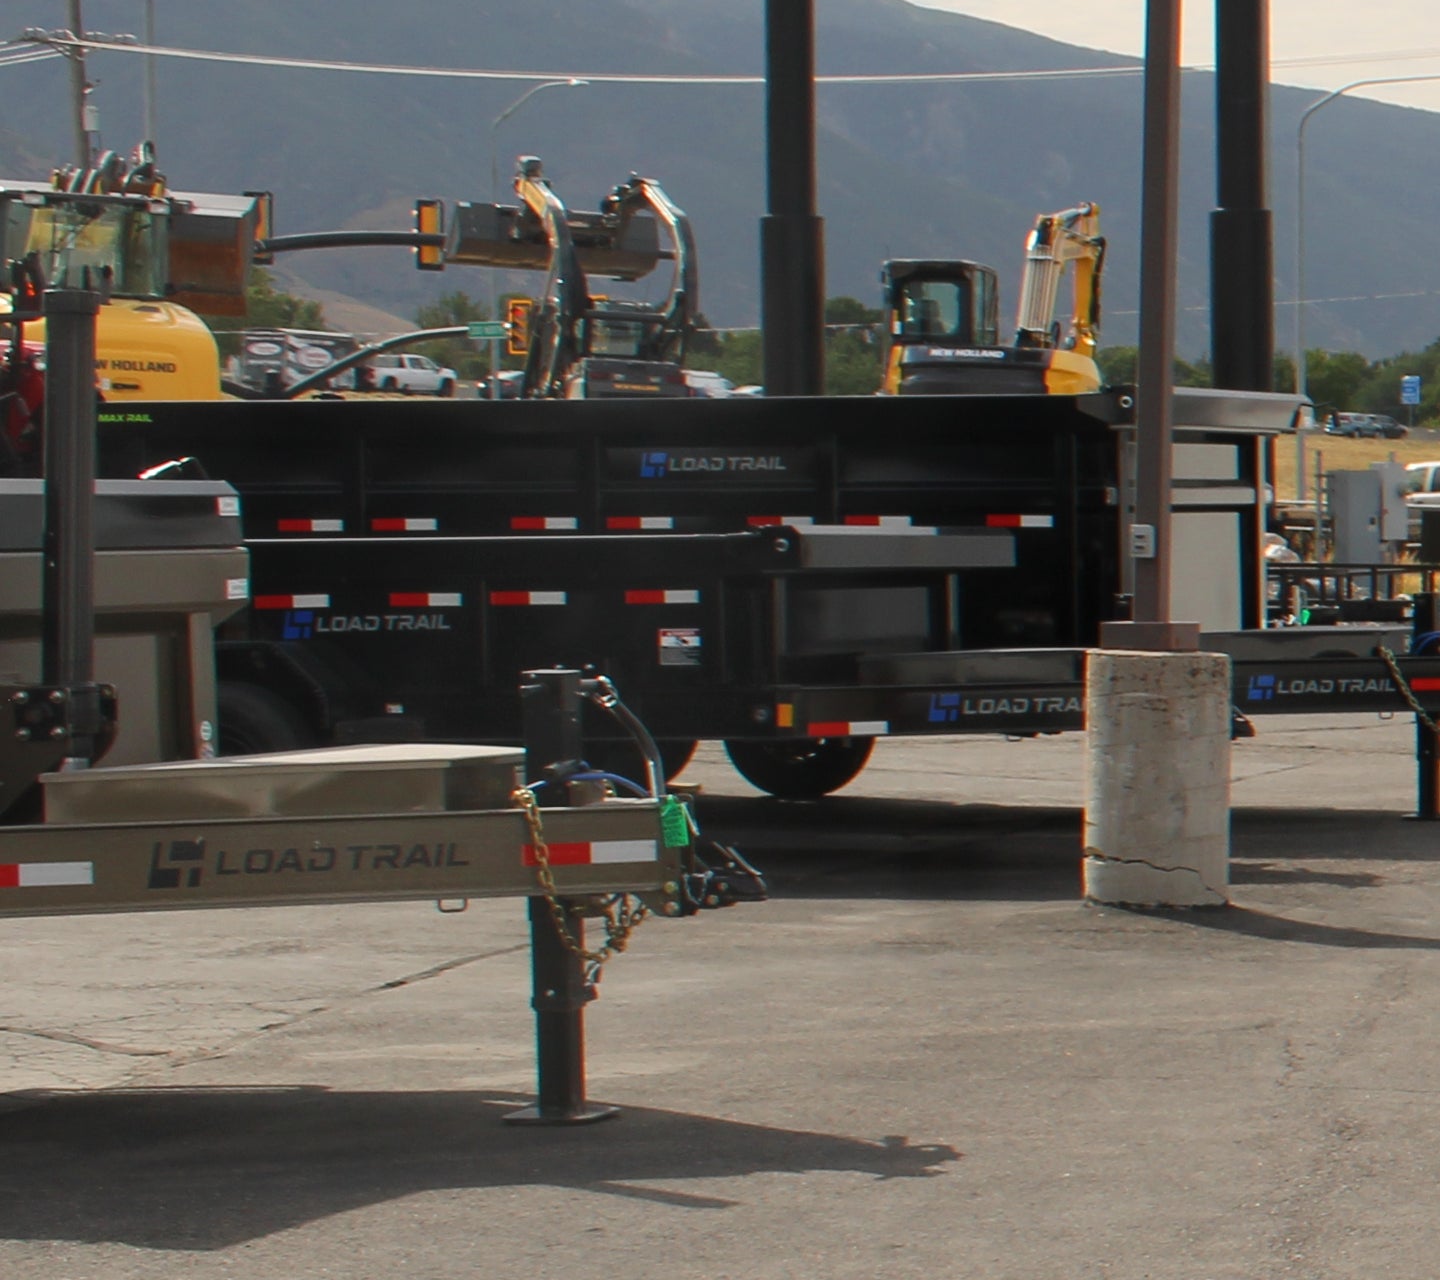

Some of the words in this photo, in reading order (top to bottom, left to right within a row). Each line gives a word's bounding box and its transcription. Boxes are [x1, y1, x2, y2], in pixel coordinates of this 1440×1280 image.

[955, 348, 1006, 359] HOLLAND
[111, 360, 177, 374] HOLLAND
[668, 457, 725, 471] LOAD
[728, 456, 787, 470] TRAIL
[316, 616, 380, 632] LOAD
[384, 614, 451, 631] TRAIL
[1276, 679, 1334, 694] LOAD
[1337, 678, 1396, 693] TRAIL
[962, 698, 1030, 715] LOAD
[1033, 697, 1083, 712] TRA
[215, 847, 337, 875] LOAD
[346, 842, 470, 870] TRAIL
